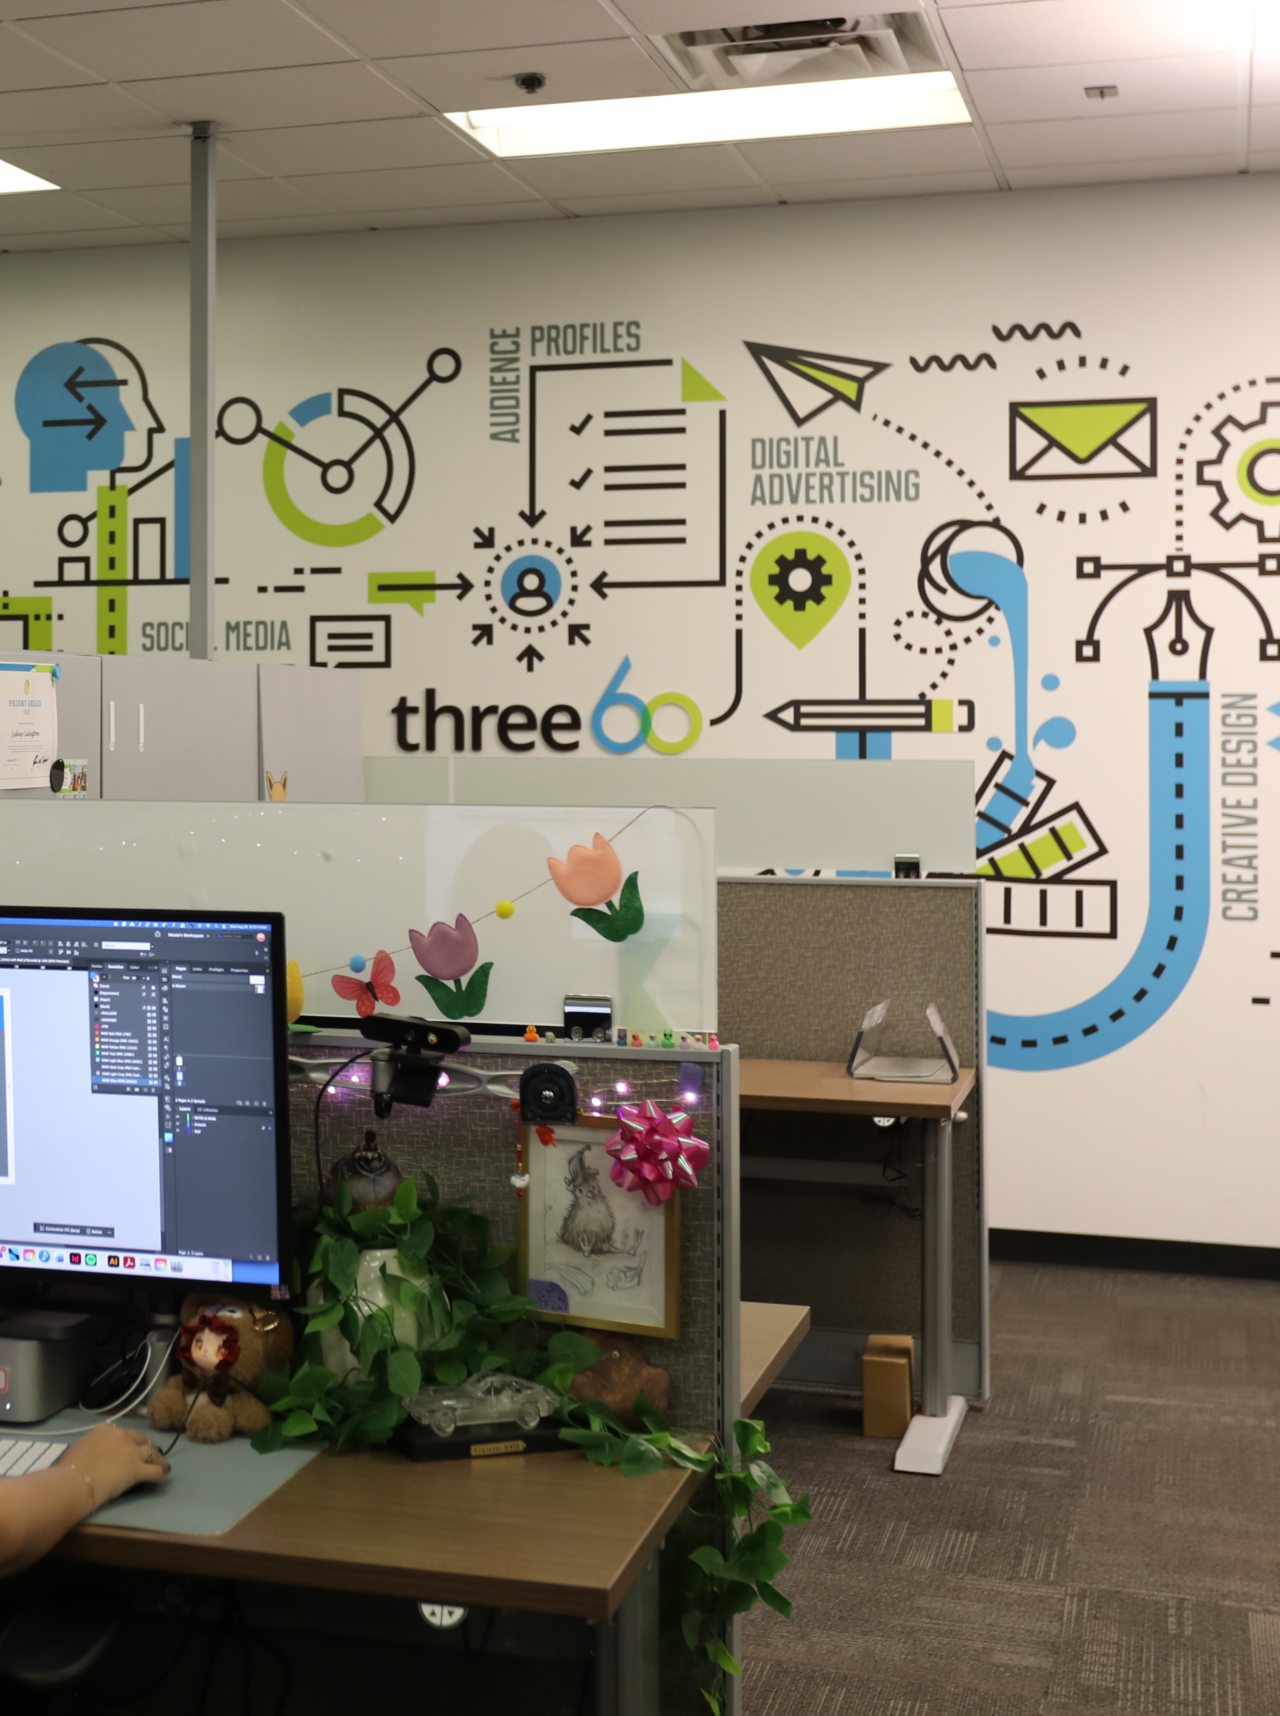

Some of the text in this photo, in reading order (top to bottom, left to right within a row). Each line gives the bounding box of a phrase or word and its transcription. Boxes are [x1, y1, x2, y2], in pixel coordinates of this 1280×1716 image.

[530, 320, 641, 357] PROFILES
[489, 326, 521, 444] AUDIENCE
[750, 435, 845, 470] DIGITAL
[750, 470, 921, 506] ADVERTISING
[225, 620, 292, 652] MEDIA
[1221, 693, 1259, 922] CREATIVE DESIGN
